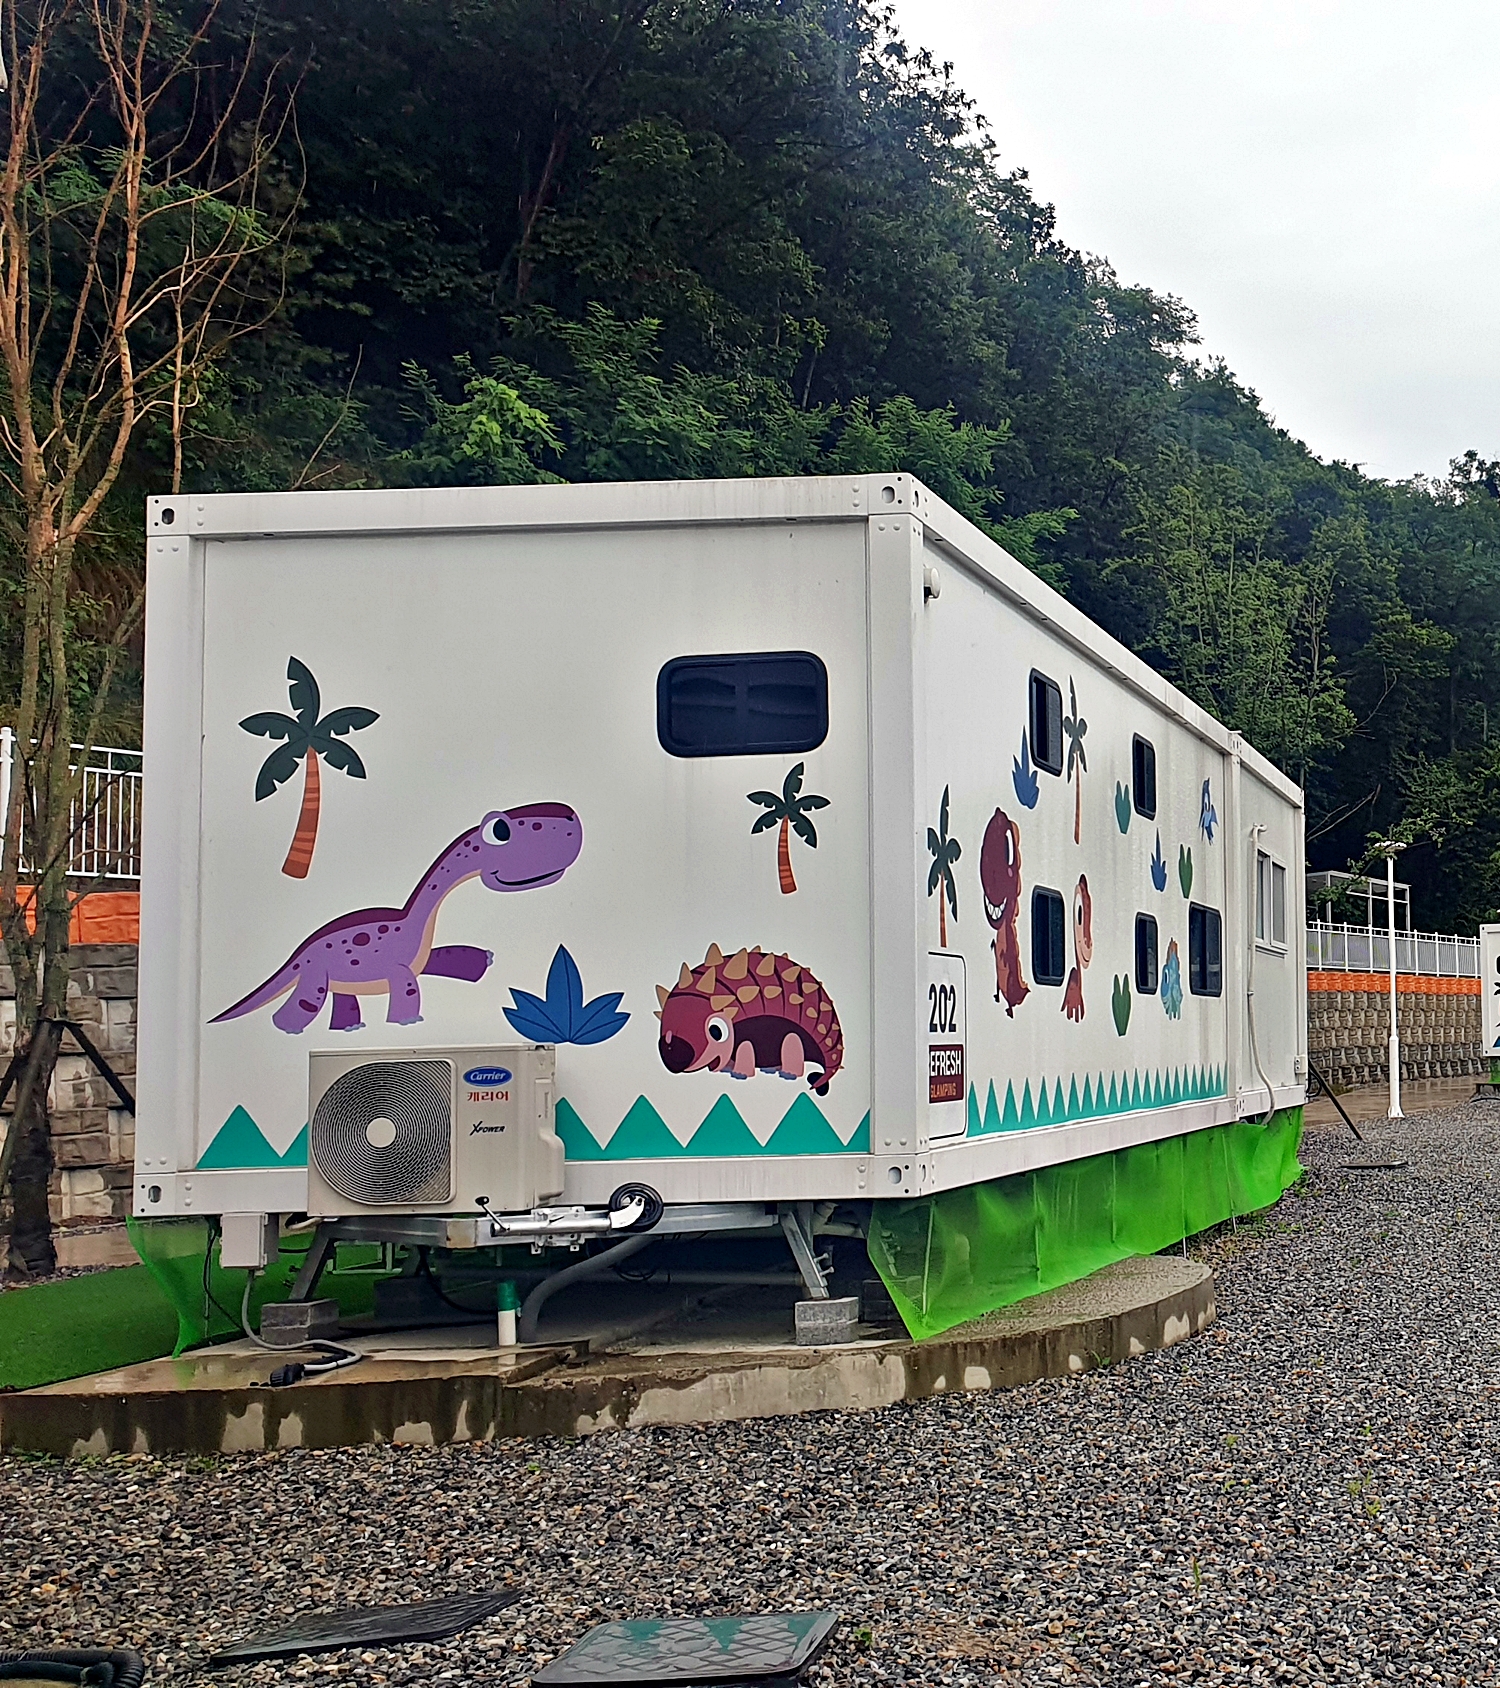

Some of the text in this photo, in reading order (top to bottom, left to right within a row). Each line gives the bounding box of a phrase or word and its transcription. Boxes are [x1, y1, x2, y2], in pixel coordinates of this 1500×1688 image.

[928, 983, 957, 1034] 202
[470, 1071, 506, 1081] Carrier
[467, 1090, 509, 1102] 캐리어
